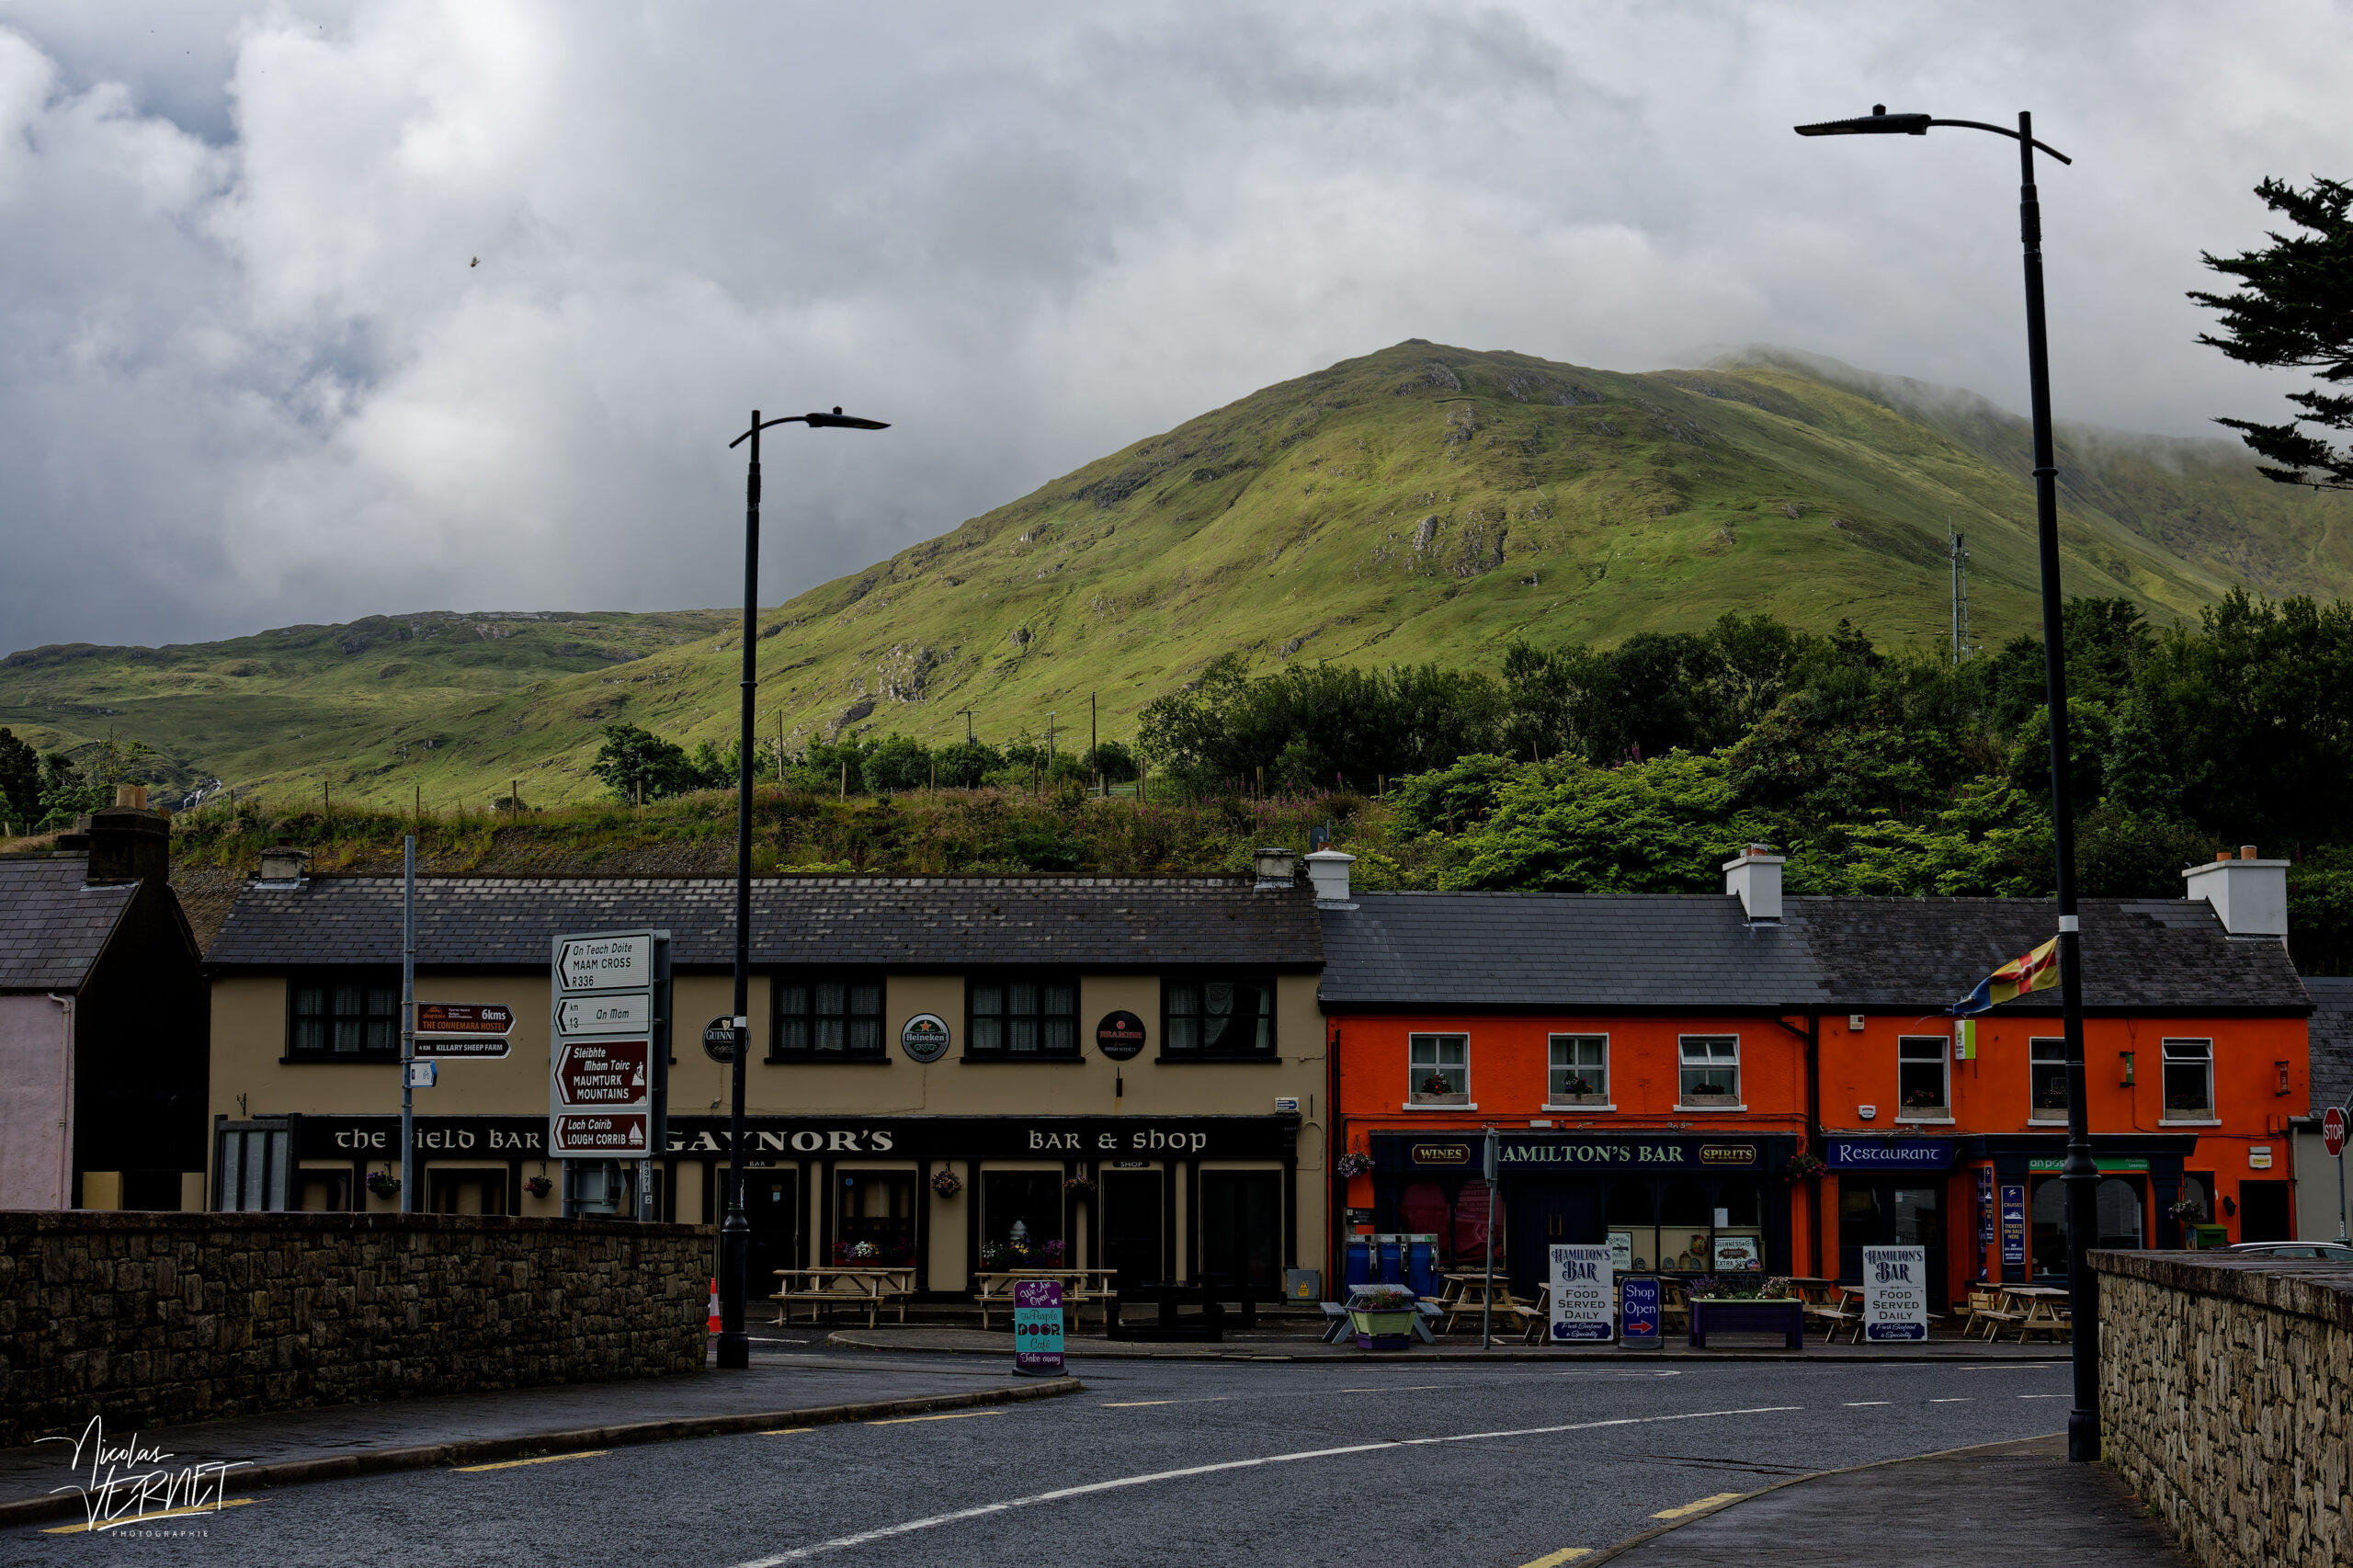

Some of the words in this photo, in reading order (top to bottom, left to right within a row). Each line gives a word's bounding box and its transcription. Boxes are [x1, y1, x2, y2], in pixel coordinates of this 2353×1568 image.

[573, 946, 584, 956] An
[586, 943, 608, 955] Teach
[573, 960, 598, 971] MAAM
[601, 957, 631, 969] CROSS
[572, 975, 594, 987] R336
[482, 1008, 506, 1020] 6kms
[596, 1009, 607, 1019] An
[423, 1021, 437, 1029] THE
[437, 1021, 480, 1030] CONNEMARA
[481, 1022, 506, 1031] HOSTEL
[569, 1017, 579, 1028] 13
[906, 1033, 945, 1041] Heineken
[573, 1047, 607, 1059] Sléibhte
[610, 1059, 631, 1071] Toirc
[573, 1074, 622, 1086] MAUMTURK
[576, 1087, 630, 1100] MOUNTAINS
[567, 1119, 585, 1130] Loch
[587, 1119, 612, 1130] Coirib
[2325, 1123, 2343, 1140] STOP
[410, 1128, 476, 1149] IELD
[489, 1129, 542, 1149] BAR
[567, 1133, 594, 1145] LOUGH
[596, 1133, 626, 1144] CORRIB
[1029, 1130, 1082, 1150] BAR
[1097, 1132, 1118, 1150] &
[1419, 1148, 1462, 1159] WINES
[1638, 1145, 1685, 1163] BAR
[1703, 1148, 1753, 1160] SPIRITS
[2029, 1159, 2044, 1167] an
[1552, 1248, 1611, 1264] HAMILTON'S
[1865, 1249, 1923, 1265] HAMILTON'S
[1562, 1261, 1600, 1283] BAR
[1875, 1262, 1913, 1284] BAR
[1019, 1288, 1036, 1299] We
[1037, 1281, 1051, 1293] Are
[1565, 1290, 1599, 1299] FOOD
[1626, 1284, 1655, 1301] Shop
[1880, 1290, 1912, 1299] FOOD
[1029, 1290, 1050, 1306] Open!
[1558, 1300, 1606, 1309] SERVED
[1624, 1301, 1656, 1317] Open
[1872, 1301, 1919, 1310] SERVED
[1029, 1309, 1058, 1323] Purple
[1564, 1311, 1599, 1320] DAILY
[1879, 1311, 1913, 1320] DAILY
[1017, 1323, 1061, 1335] DOOR
[1029, 1337, 1051, 1351] Café
[1019, 1352, 1040, 1363] Take
[1042, 1356, 1061, 1365] away
